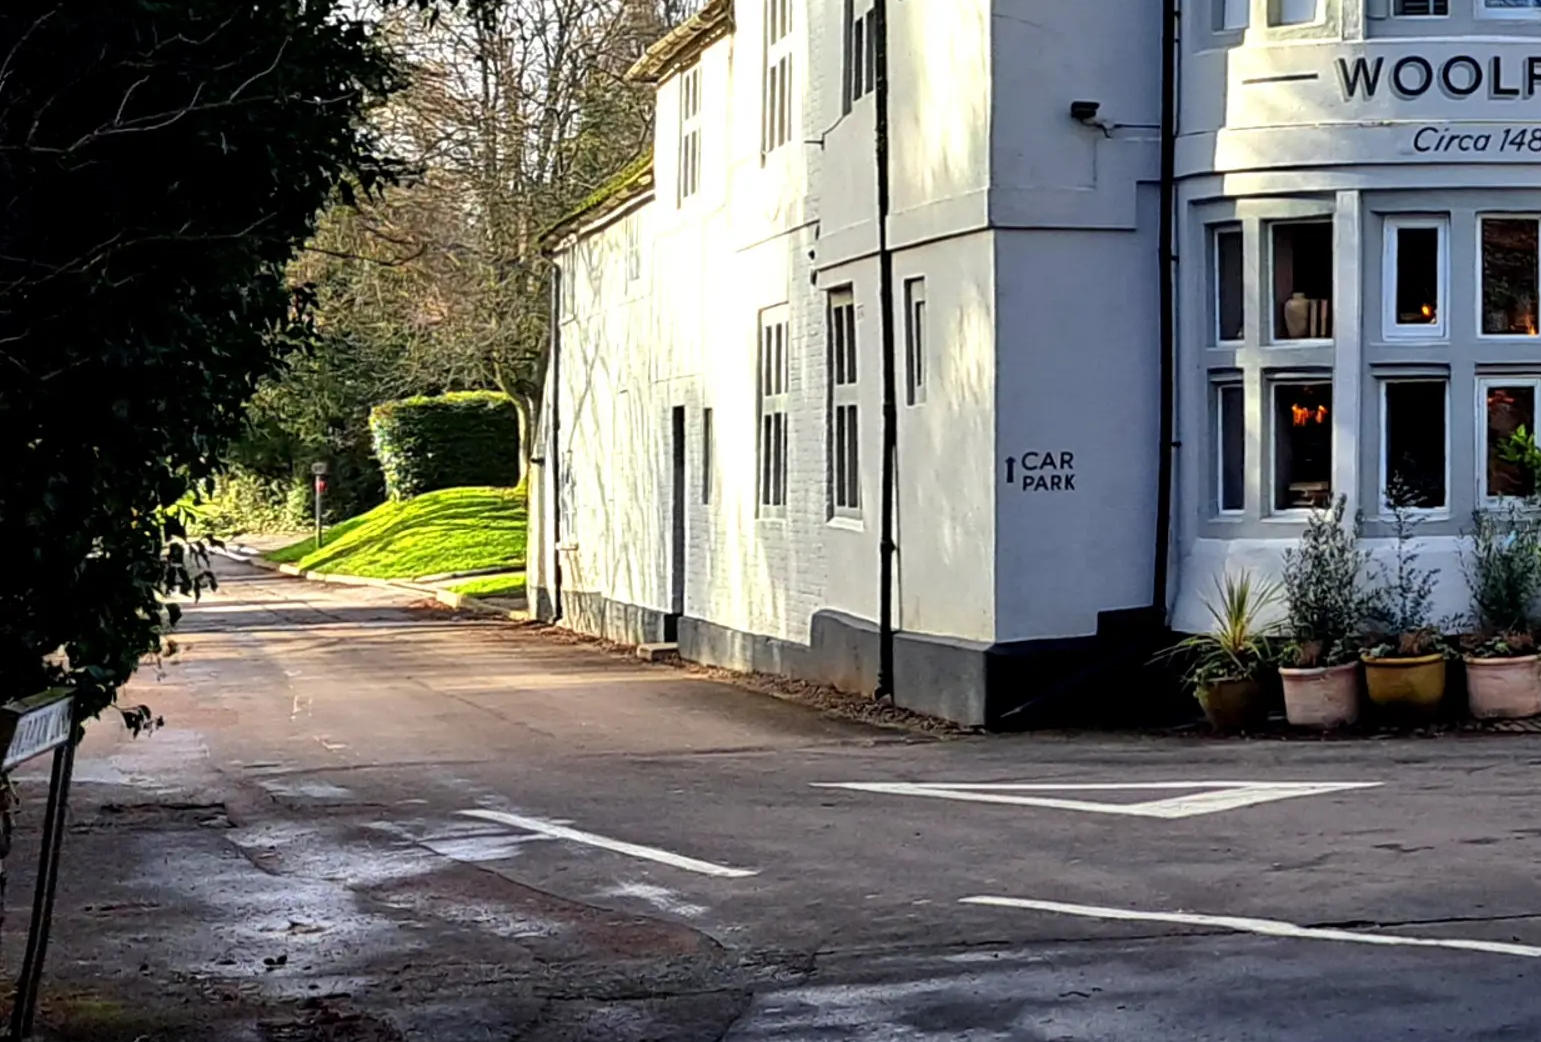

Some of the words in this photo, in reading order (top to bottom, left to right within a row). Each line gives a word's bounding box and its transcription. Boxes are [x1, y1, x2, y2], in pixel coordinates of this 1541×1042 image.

[1413, 126, 1492, 152] Circa
[1021, 451, 1074, 470] CAR
[1022, 474, 1076, 491] PARK
